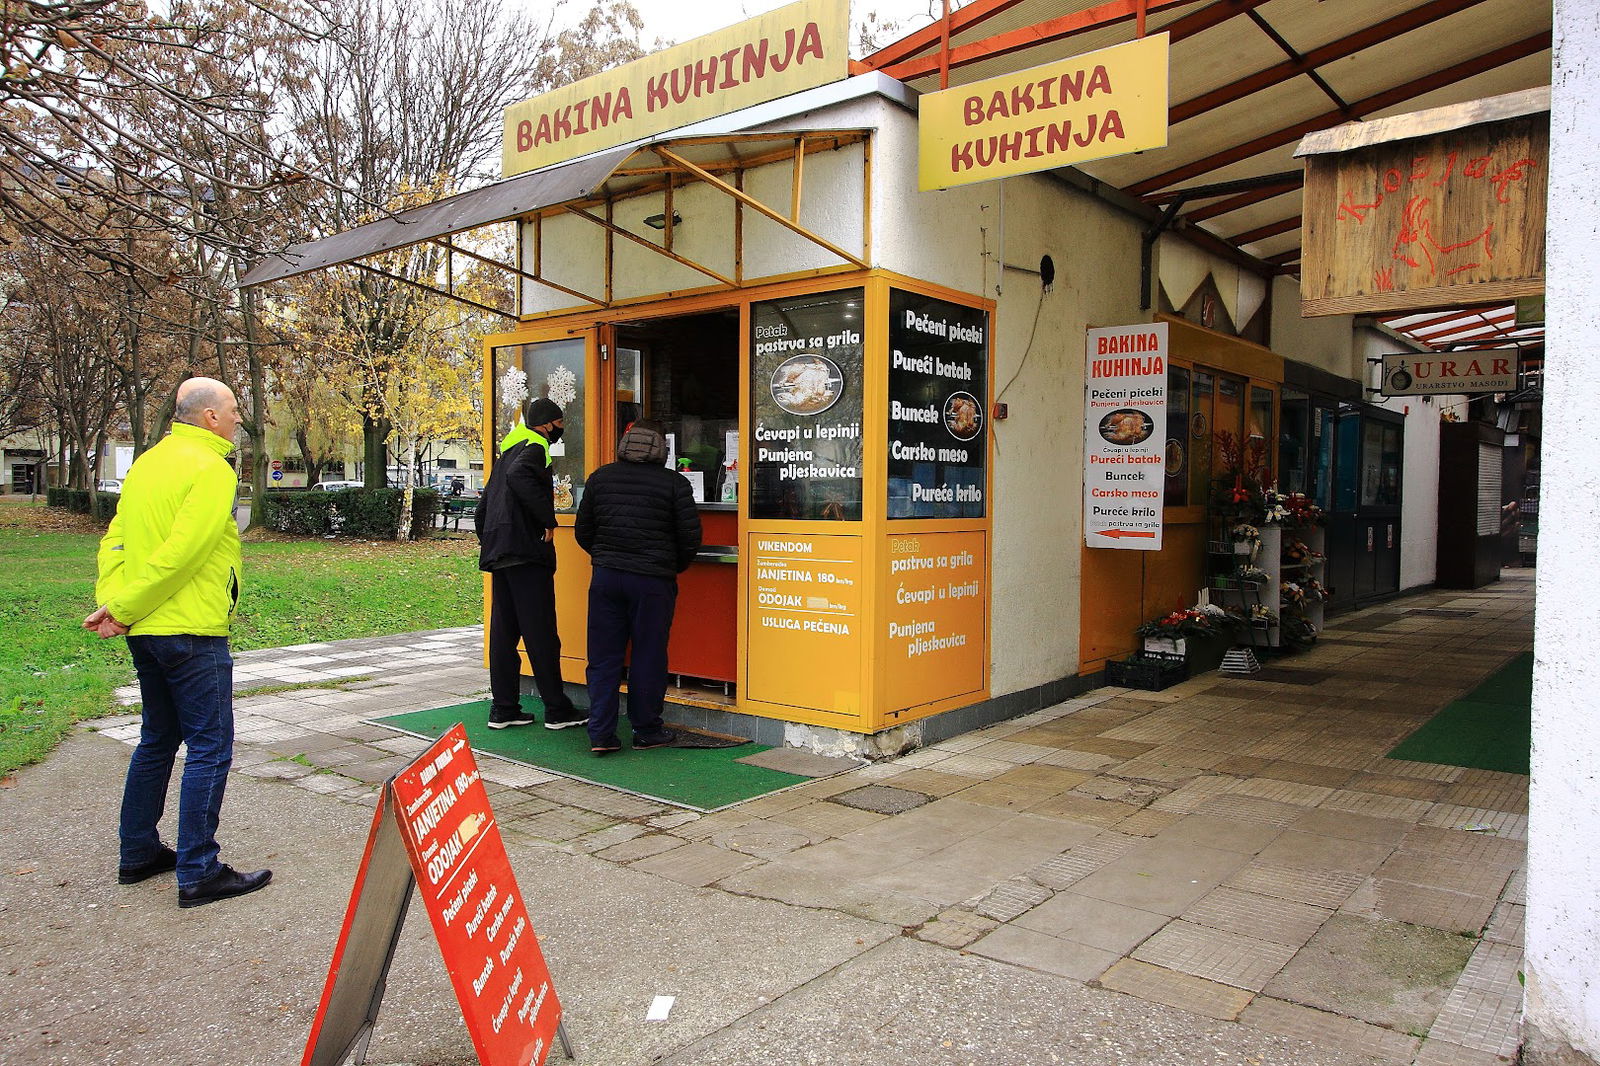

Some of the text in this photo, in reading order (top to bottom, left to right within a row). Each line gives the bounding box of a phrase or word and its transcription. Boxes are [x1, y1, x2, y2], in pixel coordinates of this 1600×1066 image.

[516, 22, 824, 152] BAKINA KUHINJA
[964, 65, 1112, 126] BAKINA
[951, 110, 1125, 173] KUHINJA
[756, 324, 788, 339] Petak
[906, 310, 983, 344] Pečeni piceki
[756, 329, 860, 356] pastrva sa grila
[1098, 332, 1158, 355] BAKINA
[893, 349, 972, 381] Pureći batak
[1092, 356, 1163, 378] KUHINJA
[1414, 358, 1513, 379] URAR
[1091, 387, 1163, 399] Pečeni piceki
[891, 400, 939, 424] Buncek
[755, 423, 860, 442] Ćevapi u lepinji
[758, 448, 813, 464] Punjena
[891, 440, 968, 463] Carsko meso
[1090, 454, 1161, 464] Pureći batak
[779, 463, 856, 481] pljeskavica
[1105, 471, 1145, 480] Buncek
[912, 483, 982, 502] Pureće krilo
[1091, 488, 1158, 498] Carsko meso
[1093, 506, 1156, 516] Pureće krilo
[758, 541, 813, 553] VIKENDOM
[892, 538, 919, 553] Petak
[891, 551, 973, 575] pastrva sa grila
[757, 568, 813, 583] JANJETINA
[817, 572, 835, 583] 180
[758, 593, 802, 606] ODOJAK
[897, 580, 978, 604] Ćevapi u lepinji
[762, 617, 850, 635] USLUGA PEČENJA
[889, 620, 935, 639] Punjena
[908, 632, 966, 658] pljeskavica
[412, 784, 458, 846] JANJETINA
[455, 772, 469, 796] 180
[428, 829, 464, 885] ODOJAK
[442, 889, 464, 927] Pečeni
[465, 883, 497, 939] Pureći batak
[486, 912, 504, 943] Carsko
[472, 956, 495, 997] Buncek
